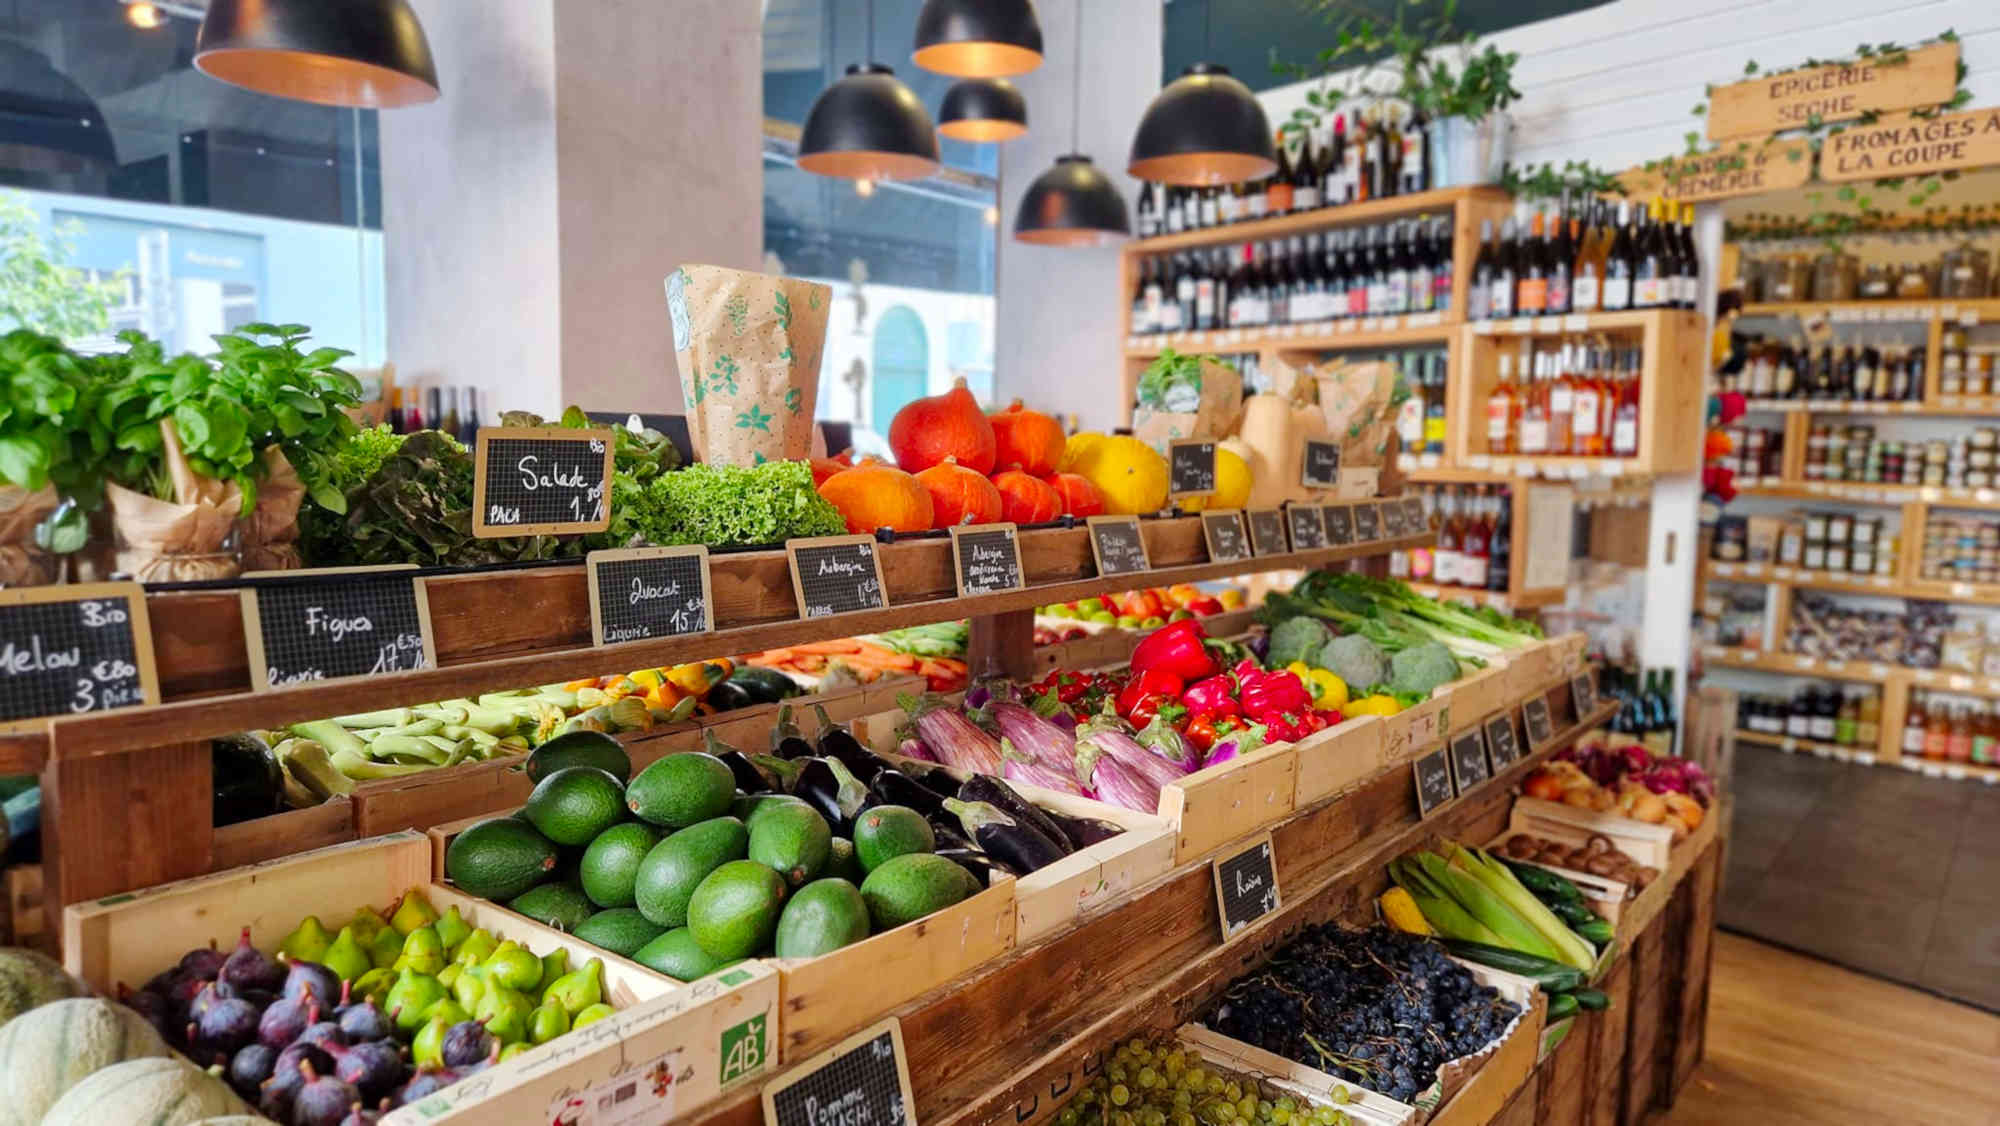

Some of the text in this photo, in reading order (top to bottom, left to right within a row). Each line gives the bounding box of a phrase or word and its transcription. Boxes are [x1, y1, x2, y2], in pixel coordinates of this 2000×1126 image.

[1769, 65, 1875, 98] EPICERIE
[1778, 95, 1856, 122] SECHE
[1835, 117, 1976, 153] FROMAGES
[1837, 141, 1968, 175] LA COUPE
[518, 455, 588, 490] Salade
[629, 577, 681, 604] Avocat
[80, 600, 127, 627] Bio
[305, 607, 374, 643] Figues
[603, 623, 651, 641] Ligurie
[722, 1034, 760, 1081] AB
[872, 1039, 892, 1061] Bio
[805, 1088, 865, 1126] Pomme
